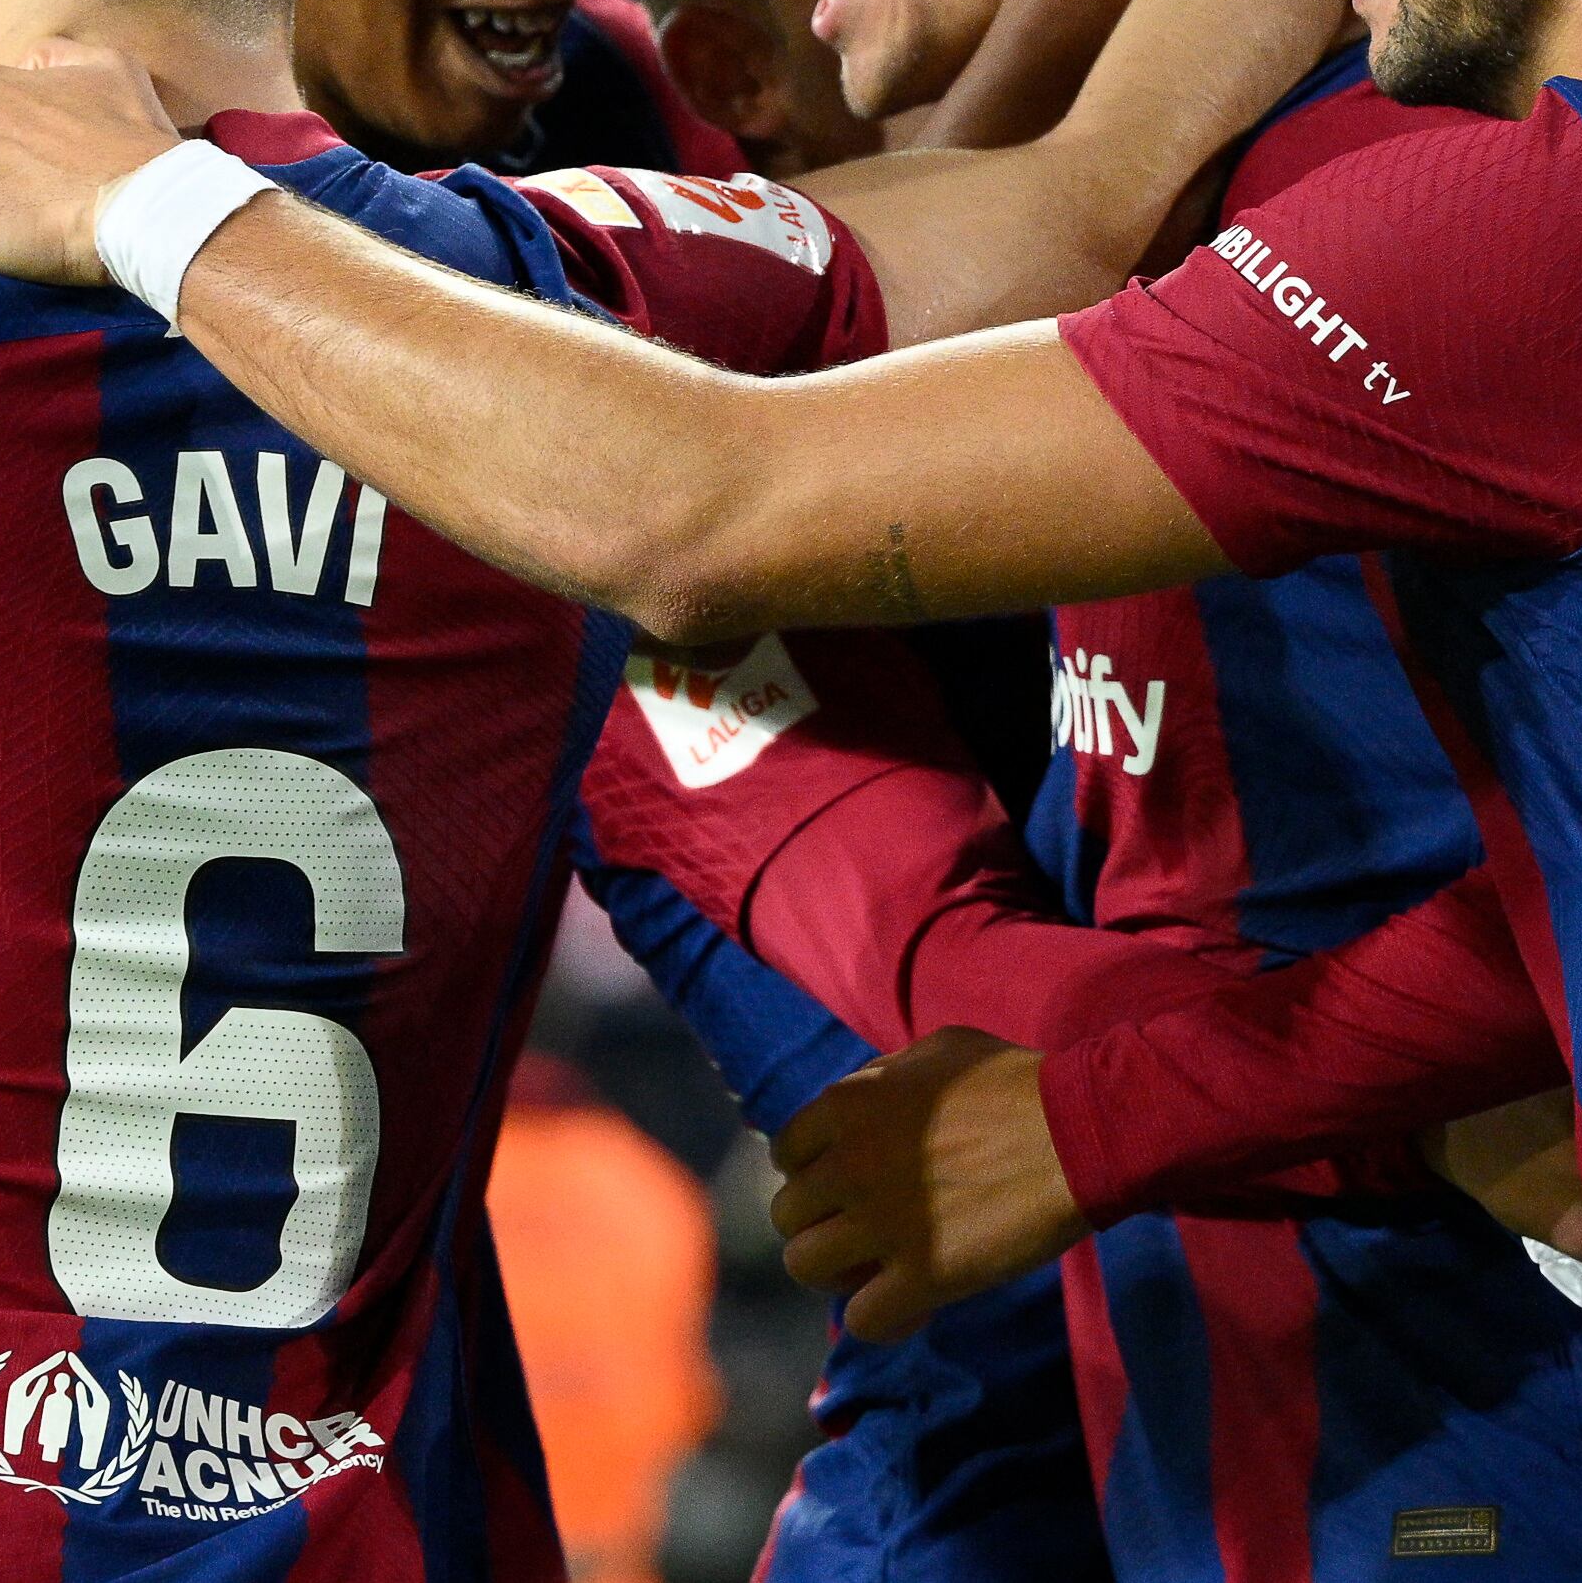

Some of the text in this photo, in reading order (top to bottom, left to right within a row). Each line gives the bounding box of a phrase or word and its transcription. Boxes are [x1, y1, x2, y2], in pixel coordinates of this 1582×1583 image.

[1208, 223, 1412, 406] MBILIGHT tv
[62, 450, 388, 607] GAVI
[689, 681, 790, 765] LALIGA
[47, 747, 406, 1329] 6
[155, 1379, 364, 1459] UNHCR
[139, 1422, 386, 1503] ACNUR
[142, 1497, 182, 1519] The
[183, 1504, 219, 1522] UN
